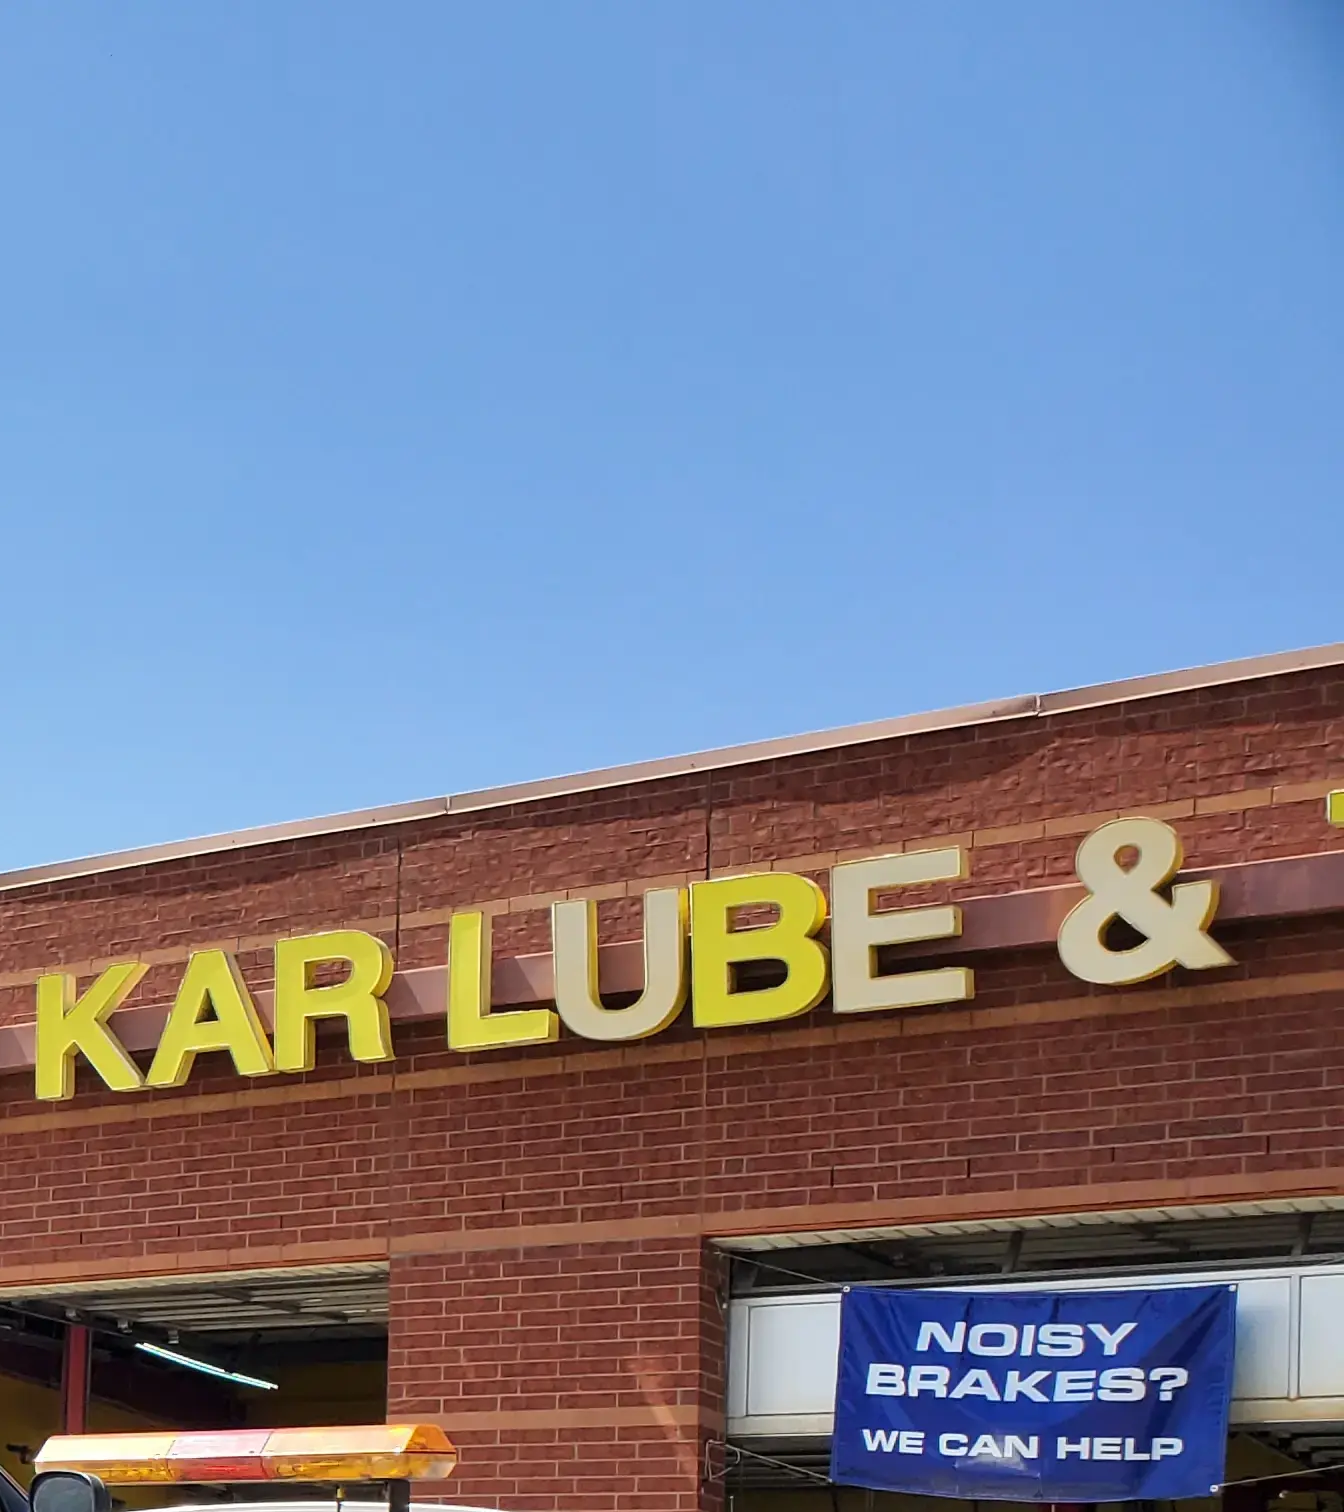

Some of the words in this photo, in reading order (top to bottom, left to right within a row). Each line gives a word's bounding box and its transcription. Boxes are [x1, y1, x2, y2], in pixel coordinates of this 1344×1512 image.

[35, 929, 395, 1101] KAR
[448, 846, 973, 1051] LUBE
[1056, 815, 1238, 985] &
[915, 1321, 1138, 1357] NOISY
[865, 1363, 1189, 1403] BRAKES?
[862, 1429, 925, 1454] WE
[938, 1433, 1040, 1460] CAN
[1056, 1437, 1183, 1461] HELP
